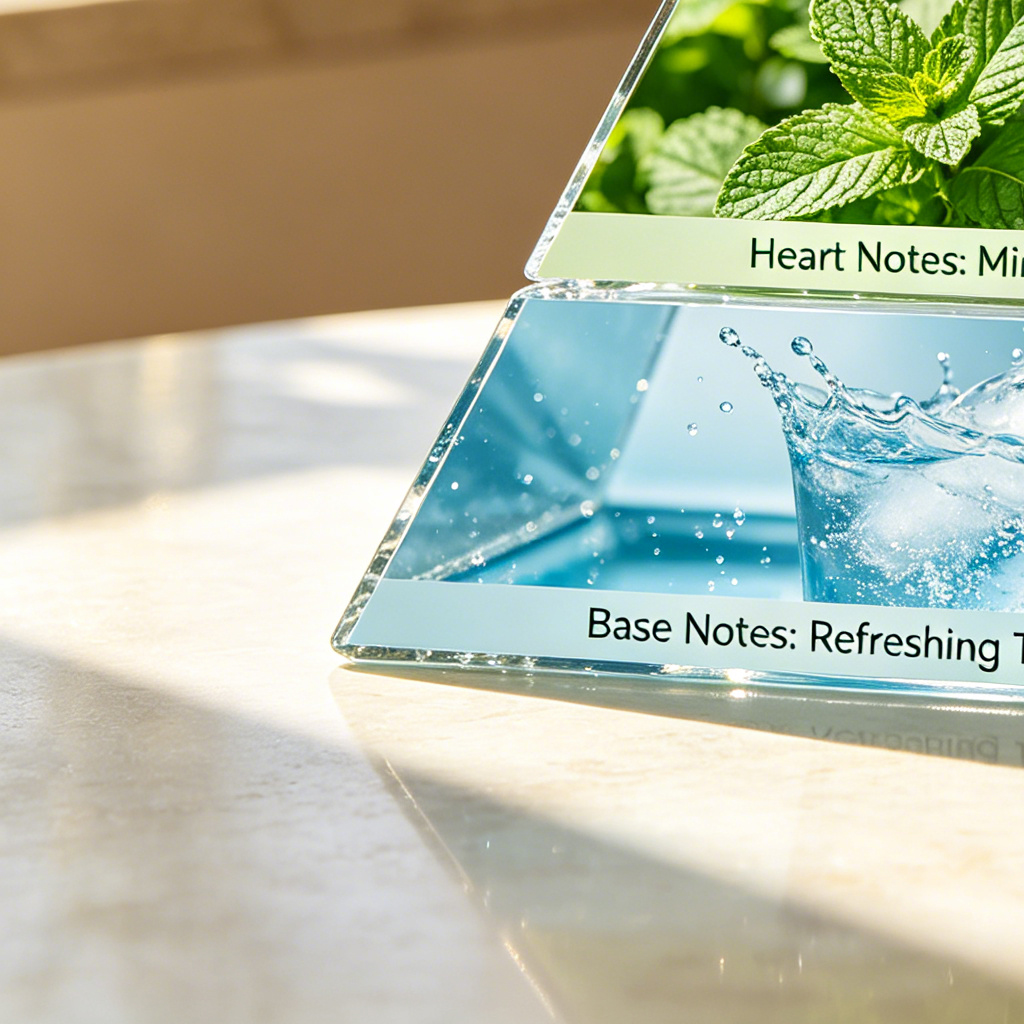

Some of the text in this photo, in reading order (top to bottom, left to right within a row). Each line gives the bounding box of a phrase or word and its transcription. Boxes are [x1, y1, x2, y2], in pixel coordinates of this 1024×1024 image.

[750, 238, 846, 272] Heart
[858, 240, 966, 276] Notes:
[588, 607, 673, 643] Base
[685, 611, 797, 650] Notes:
[811, 619, 1000, 673] Refreshing
